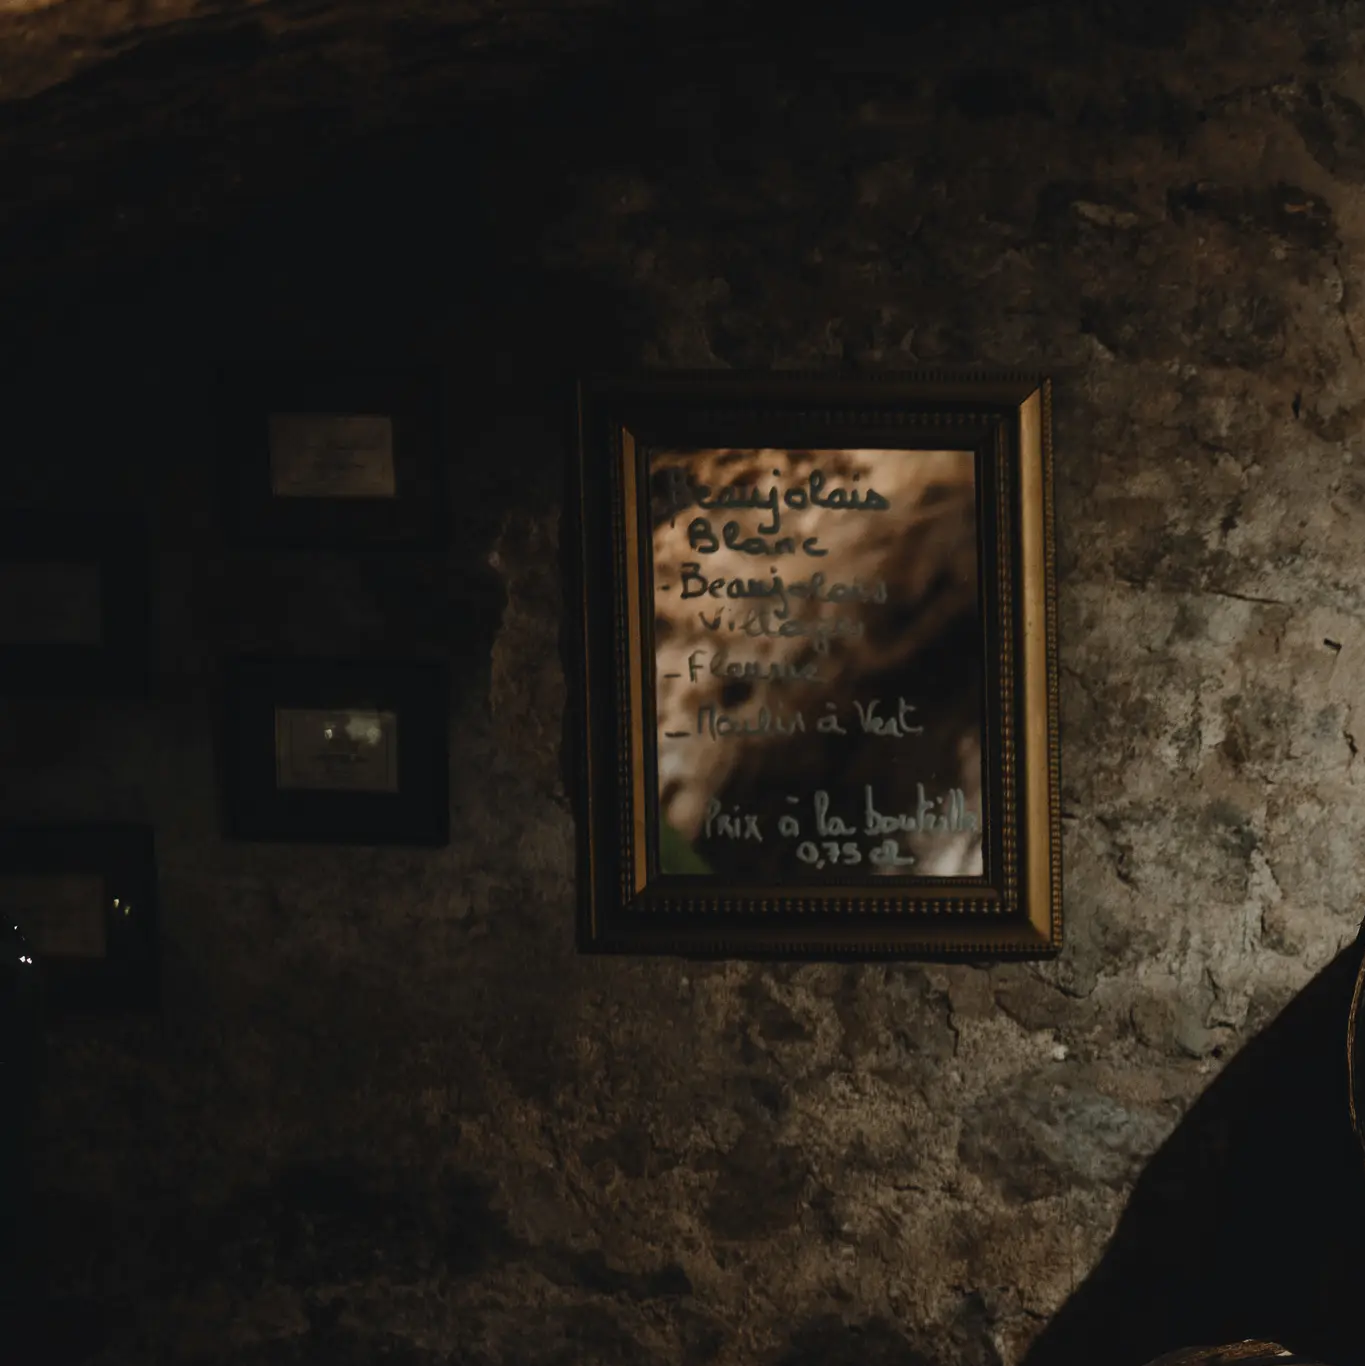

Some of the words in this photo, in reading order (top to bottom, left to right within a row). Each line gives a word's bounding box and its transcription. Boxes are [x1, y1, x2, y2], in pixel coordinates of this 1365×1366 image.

[687, 516, 828, 556] Blanc
[779, 795, 799, 837] à
[814, 789, 857, 836] la
[796, 841, 861, 870] 0,75
